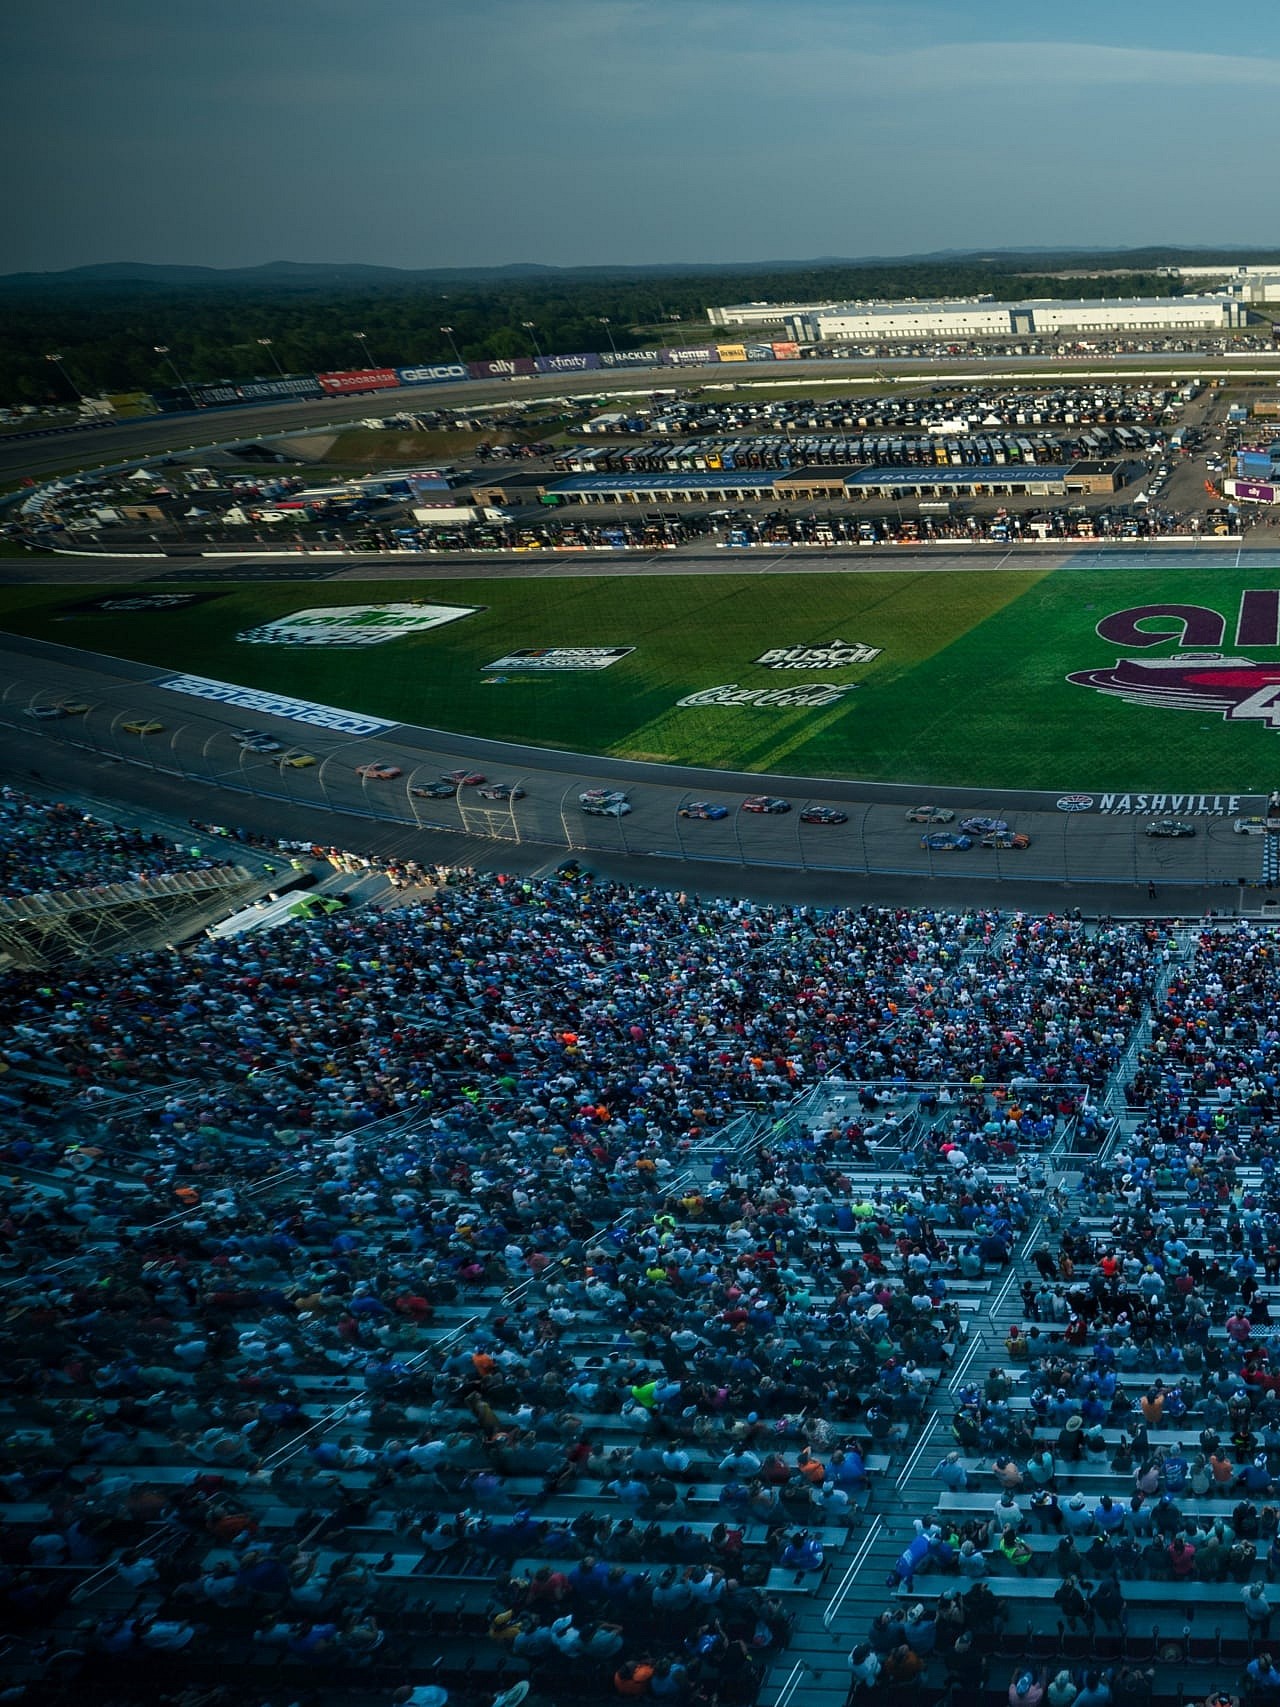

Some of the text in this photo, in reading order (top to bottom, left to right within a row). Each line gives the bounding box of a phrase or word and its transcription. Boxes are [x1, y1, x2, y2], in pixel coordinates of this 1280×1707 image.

[615, 351, 657, 361] RACKLEY
[678, 350, 710, 360] LOTTERY
[488, 360, 515, 374] ally
[549, 357, 587, 370] xfinity
[343, 373, 395, 386] DOORDASH
[400, 366, 464, 381] GEICO
[880, 471, 1059, 481] RACKLEY ROOFING
[592, 479, 680, 487] RACKLEY
[282, 611, 441, 627] LOTTERY
[302, 631, 410, 645] 250
[756, 648, 883, 664] BUSCH
[769, 661, 847, 669] LIGHT
[159, 678, 382, 735] GEICO GEICO GEICO
[1099, 794, 1240, 810] NASHVILLE
[1100, 809, 1234, 817] SUPERSPEEDWAY
